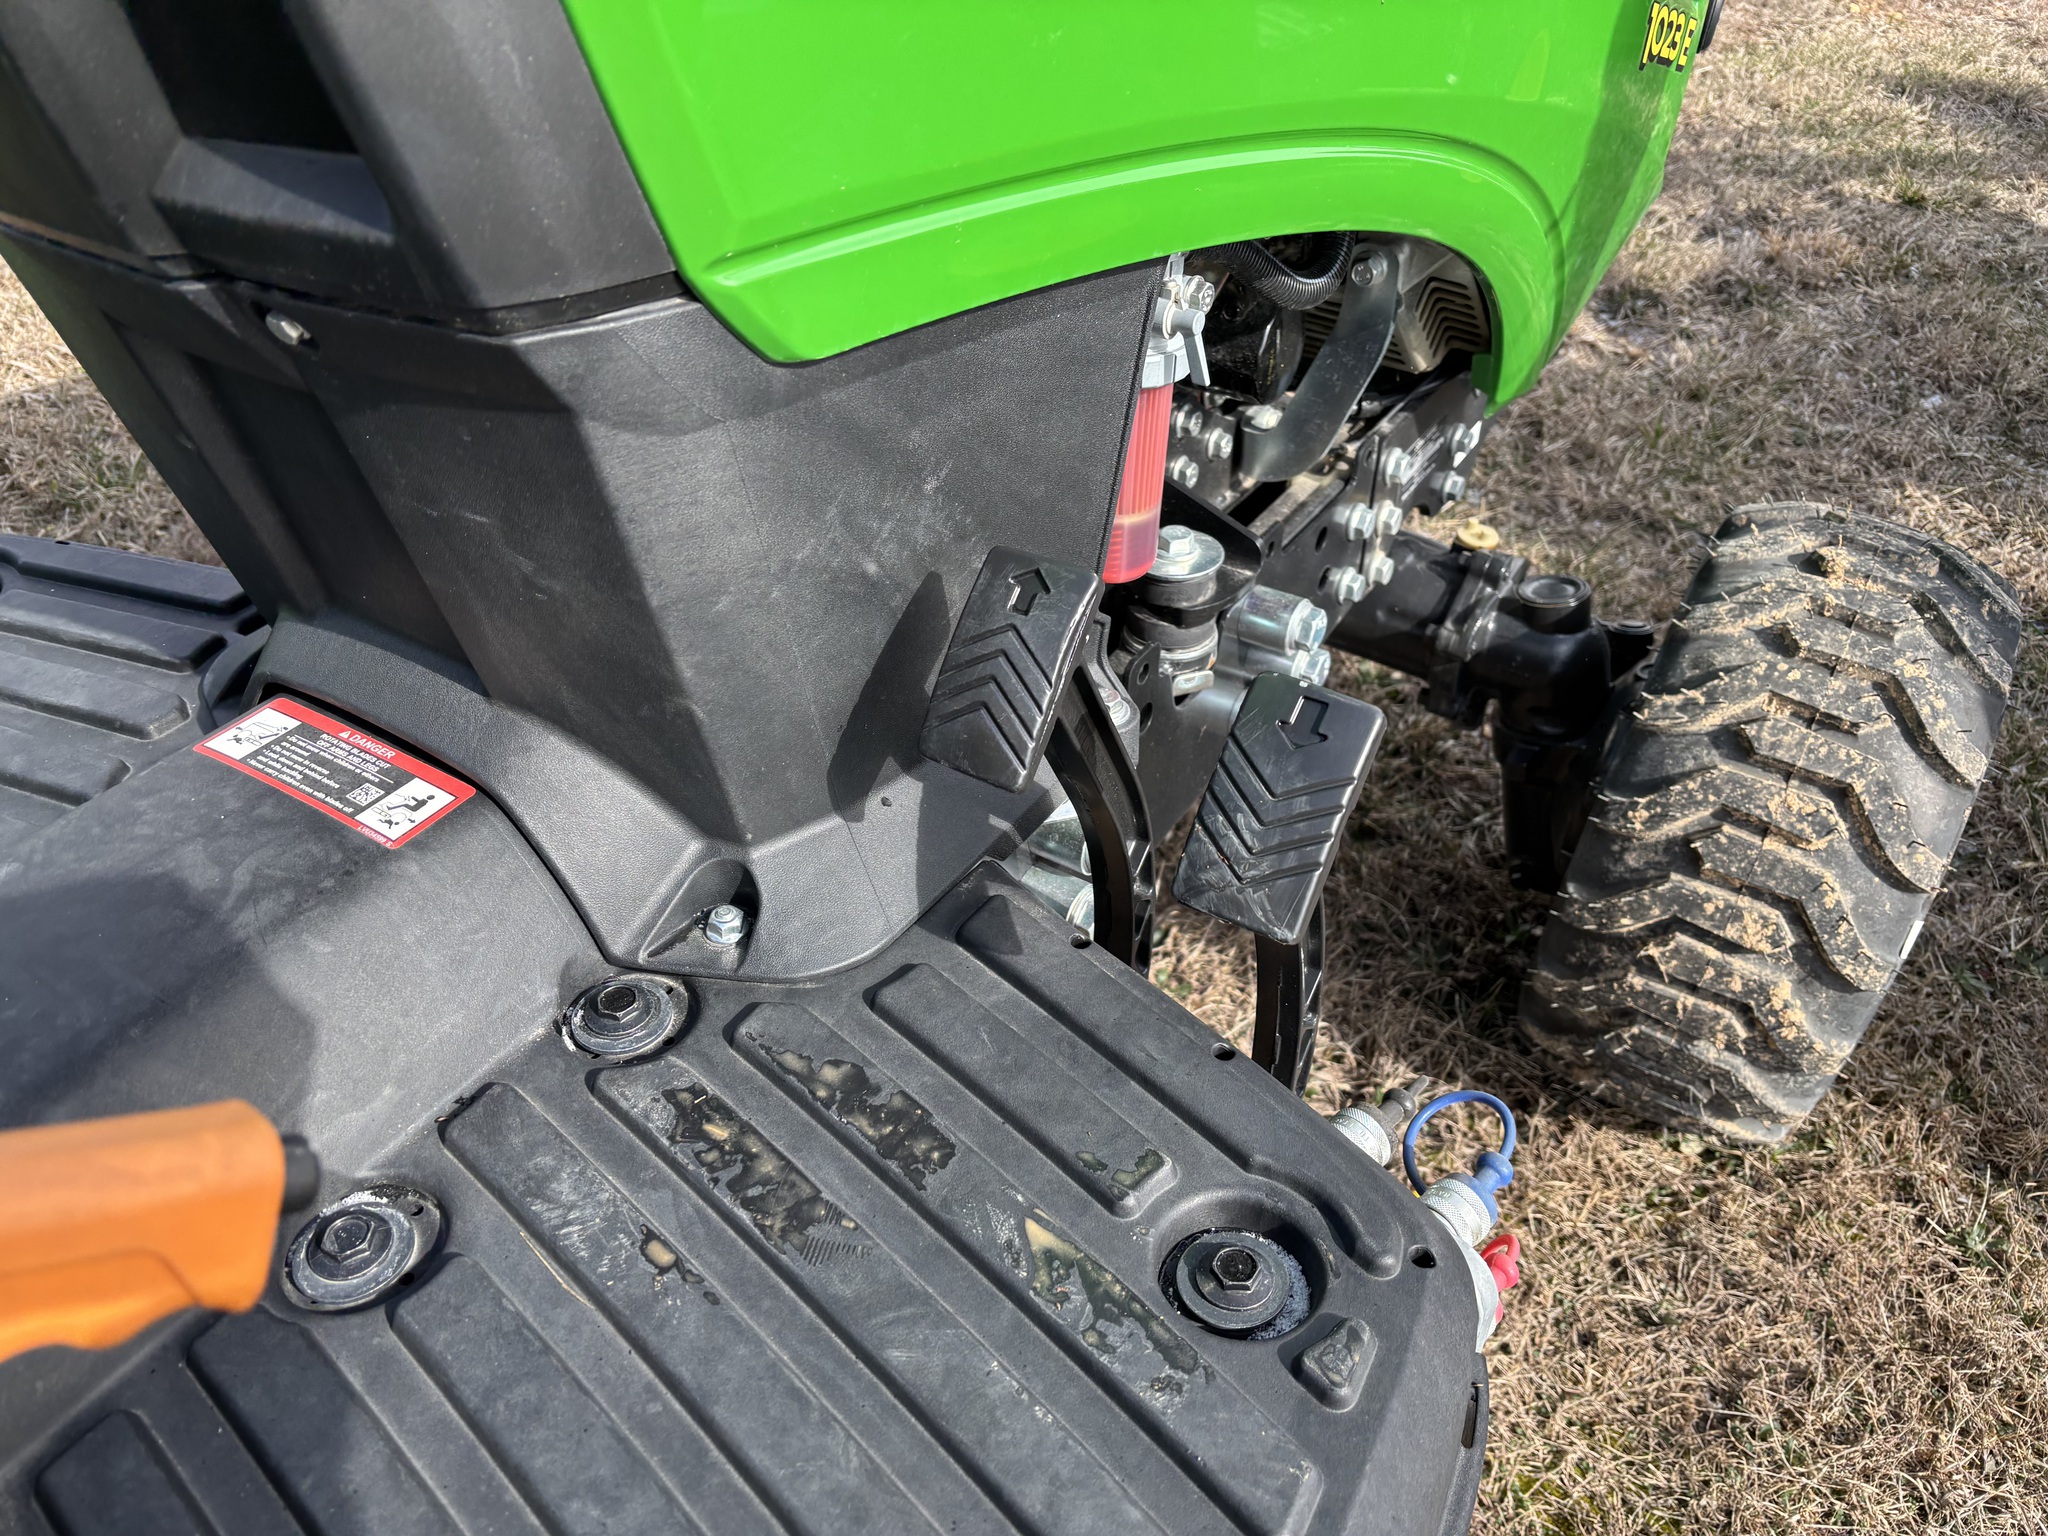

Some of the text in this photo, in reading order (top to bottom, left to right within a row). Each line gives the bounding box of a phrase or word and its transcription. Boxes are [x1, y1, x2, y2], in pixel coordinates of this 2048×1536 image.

[290, 745, 311, 757] around
[320, 733, 391, 769] ROTATING BLADES CUT
[328, 746, 349, 757] ARMS
[346, 754, 362, 764] AND
[361, 761, 379, 772] LEGS
[349, 734, 396, 759] DANGER
[267, 760, 282, 769] while
[281, 766, 303, 780] backing
[278, 757, 294, 766] down
[303, 768, 324, 780] behind
[321, 777, 340, 789] before
[290, 754, 304, 762] mow
[309, 763, 330, 774] reverse
[306, 745, 320, 753] mow
[319, 751, 334, 760] when
[333, 758, 356, 770] children
[361, 772, 380, 782] others
[249, 759, 266, 769] Never
[264, 767, 280, 777] carry
[278, 773, 300, 787] children
[299, 784, 314, 793] even
[312, 791, 326, 799] with
[324, 796, 344, 809] blades
